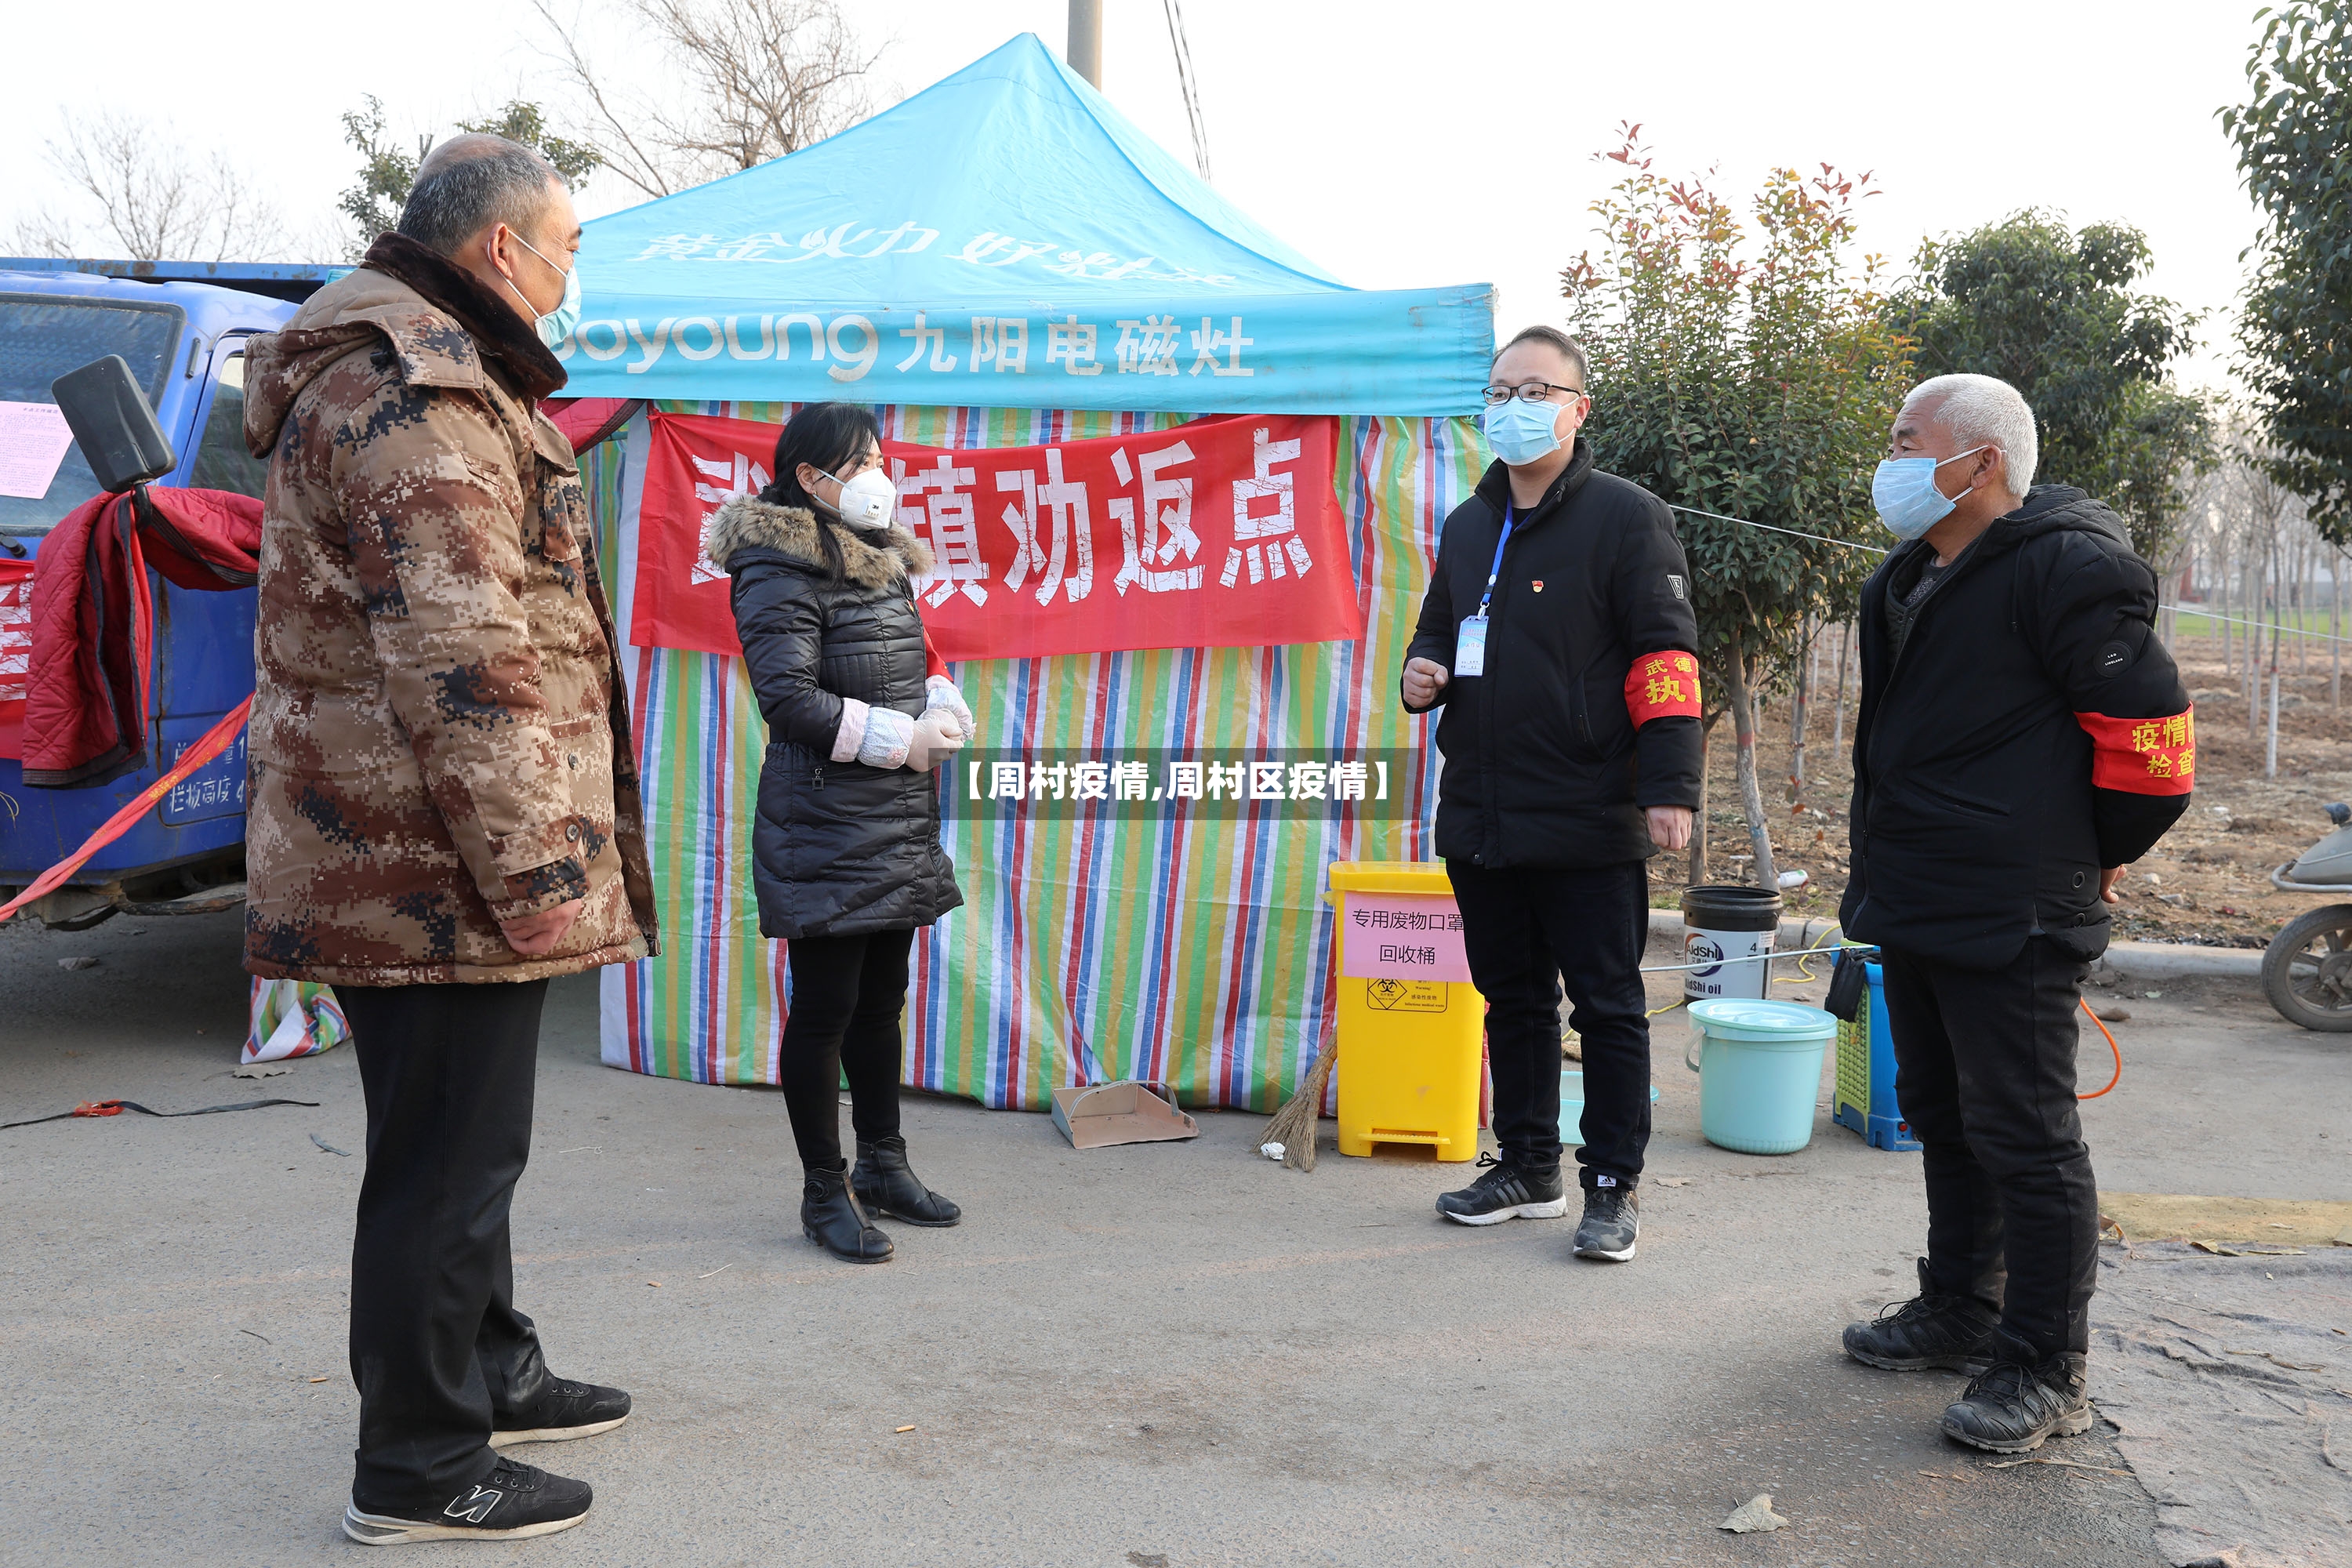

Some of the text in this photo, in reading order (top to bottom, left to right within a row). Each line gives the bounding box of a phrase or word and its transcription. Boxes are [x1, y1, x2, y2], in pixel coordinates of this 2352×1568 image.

[895, 314, 1254, 377] 九阳电磁灶
[1646, 657, 1699, 677] 武德
[1352, 909, 1465, 932] 专用废物口罩
[1380, 945, 1436, 965] 回收桶
[1708, 984, 1721, 994] oil
